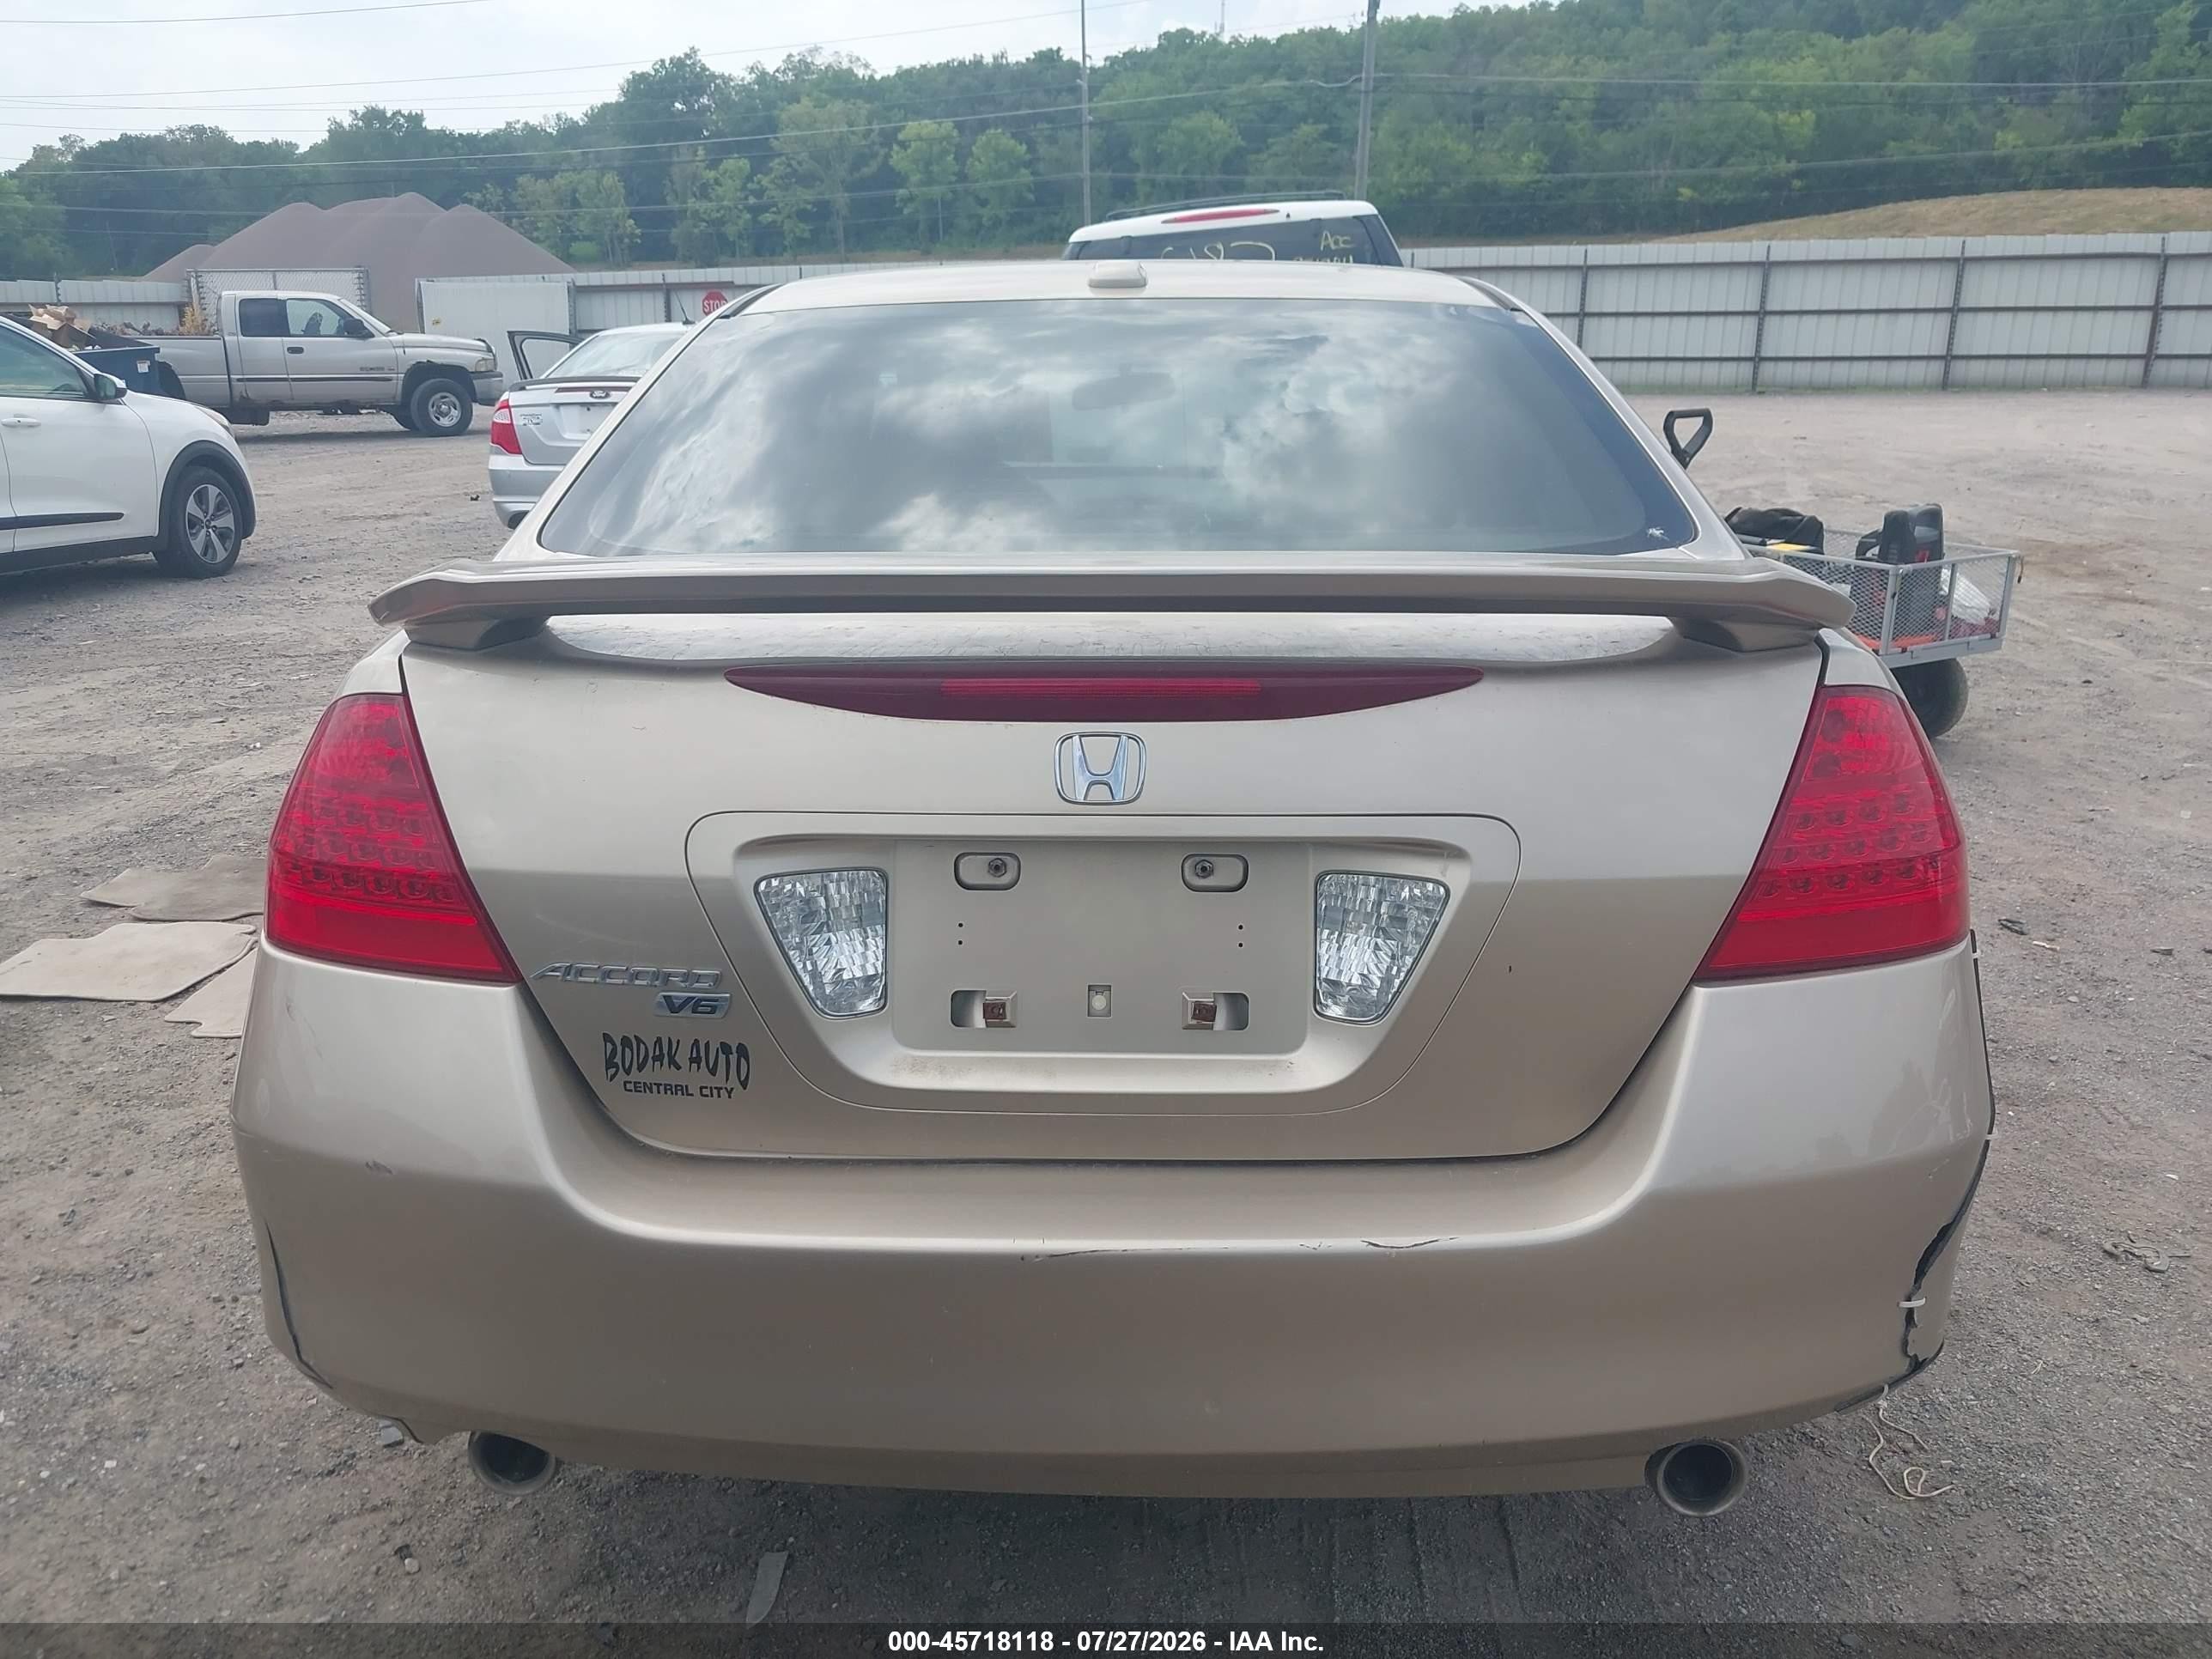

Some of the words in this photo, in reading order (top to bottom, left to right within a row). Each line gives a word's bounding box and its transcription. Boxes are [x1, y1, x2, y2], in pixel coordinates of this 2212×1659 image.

[530, 963, 723, 988] ACCORD
[662, 995, 720, 1015] V6
[602, 1031, 683, 1083] BODAK
[688, 1038, 751, 1091] AUTO
[623, 1080, 695, 1097] CENTRAL
[699, 1085, 735, 1099] CITY
